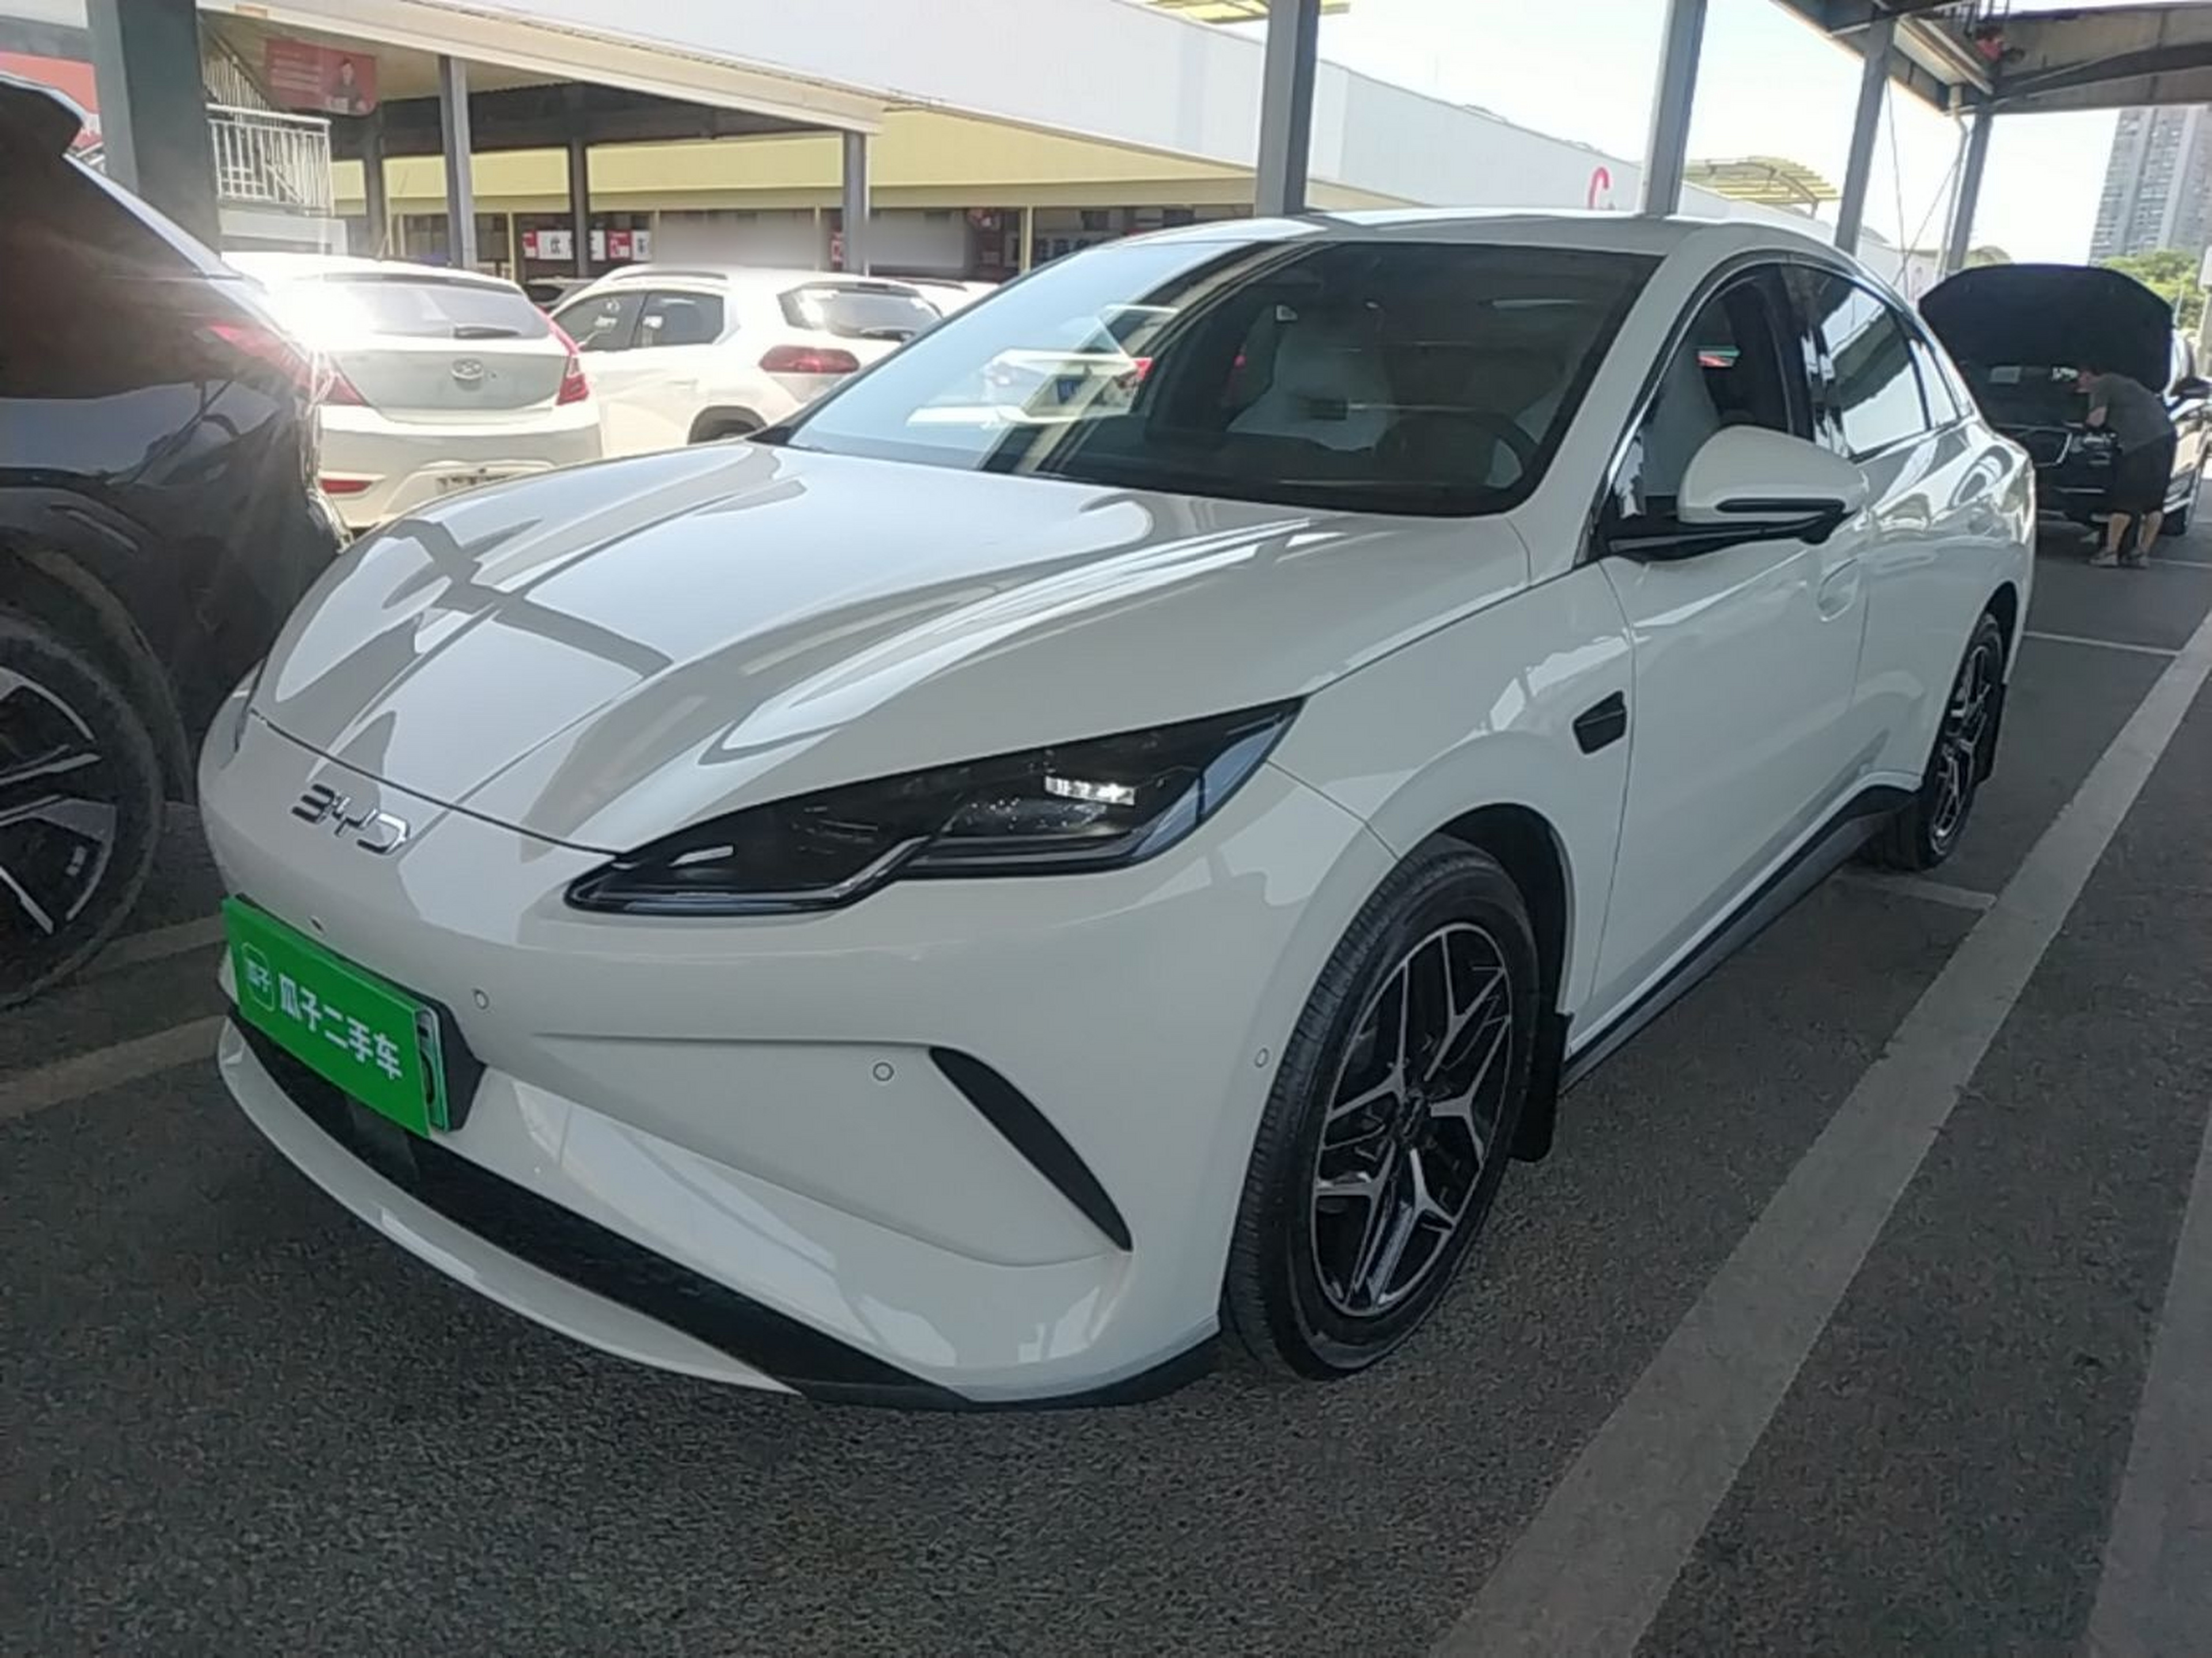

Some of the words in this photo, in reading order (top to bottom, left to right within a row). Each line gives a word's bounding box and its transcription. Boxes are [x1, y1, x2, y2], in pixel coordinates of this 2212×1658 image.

[291, 783, 410, 855] BYD
[279, 973, 403, 1080] 瓜子二手车
